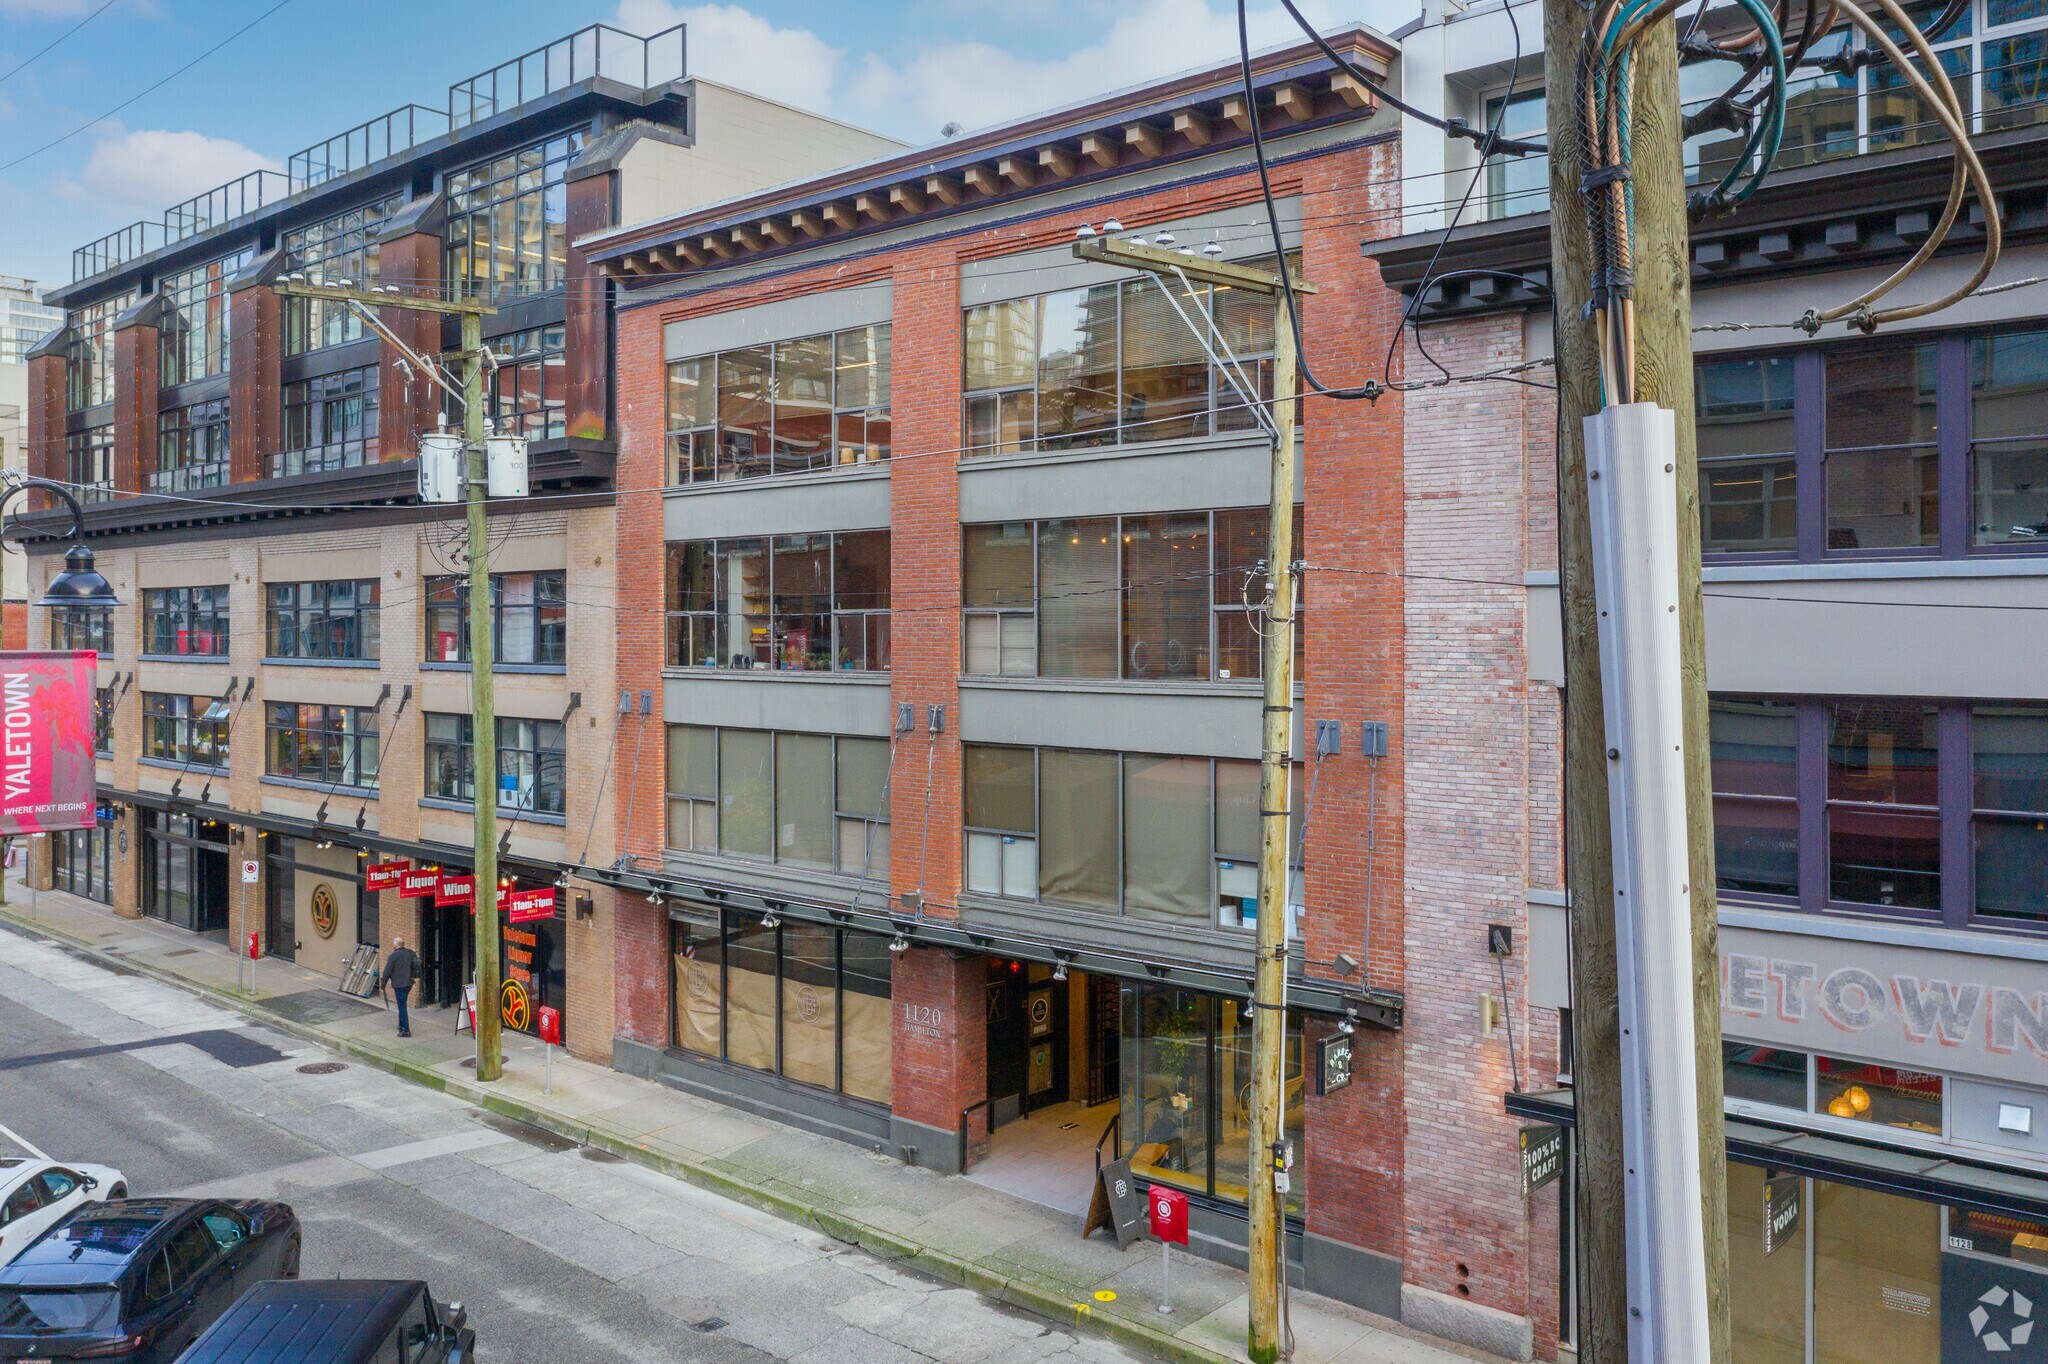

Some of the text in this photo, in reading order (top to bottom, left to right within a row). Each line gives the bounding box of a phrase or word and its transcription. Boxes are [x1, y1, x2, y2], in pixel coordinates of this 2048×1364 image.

[4, 673, 31, 800] YALETOWN
[4, 802, 87, 816] WHERE NEXT BEGINS
[406, 876, 438, 889] Liquor
[444, 883, 470, 896] Wine
[513, 898, 553, 911] 11am-11pm
[507, 945, 532, 965] Liquor
[509, 964, 530, 983] Store
[904, 1003, 941, 1026] 1120
[1721, 952, 2048, 1059] ETOWN
[904, 1022, 941, 1038] HAMILTON
[1528, 1137, 1560, 1167] 100% BC
[1532, 1155, 1557, 1181] CRAFT
[1773, 1201, 1798, 1234] VODKA
[1950, 1237, 1972, 1249] 1128
